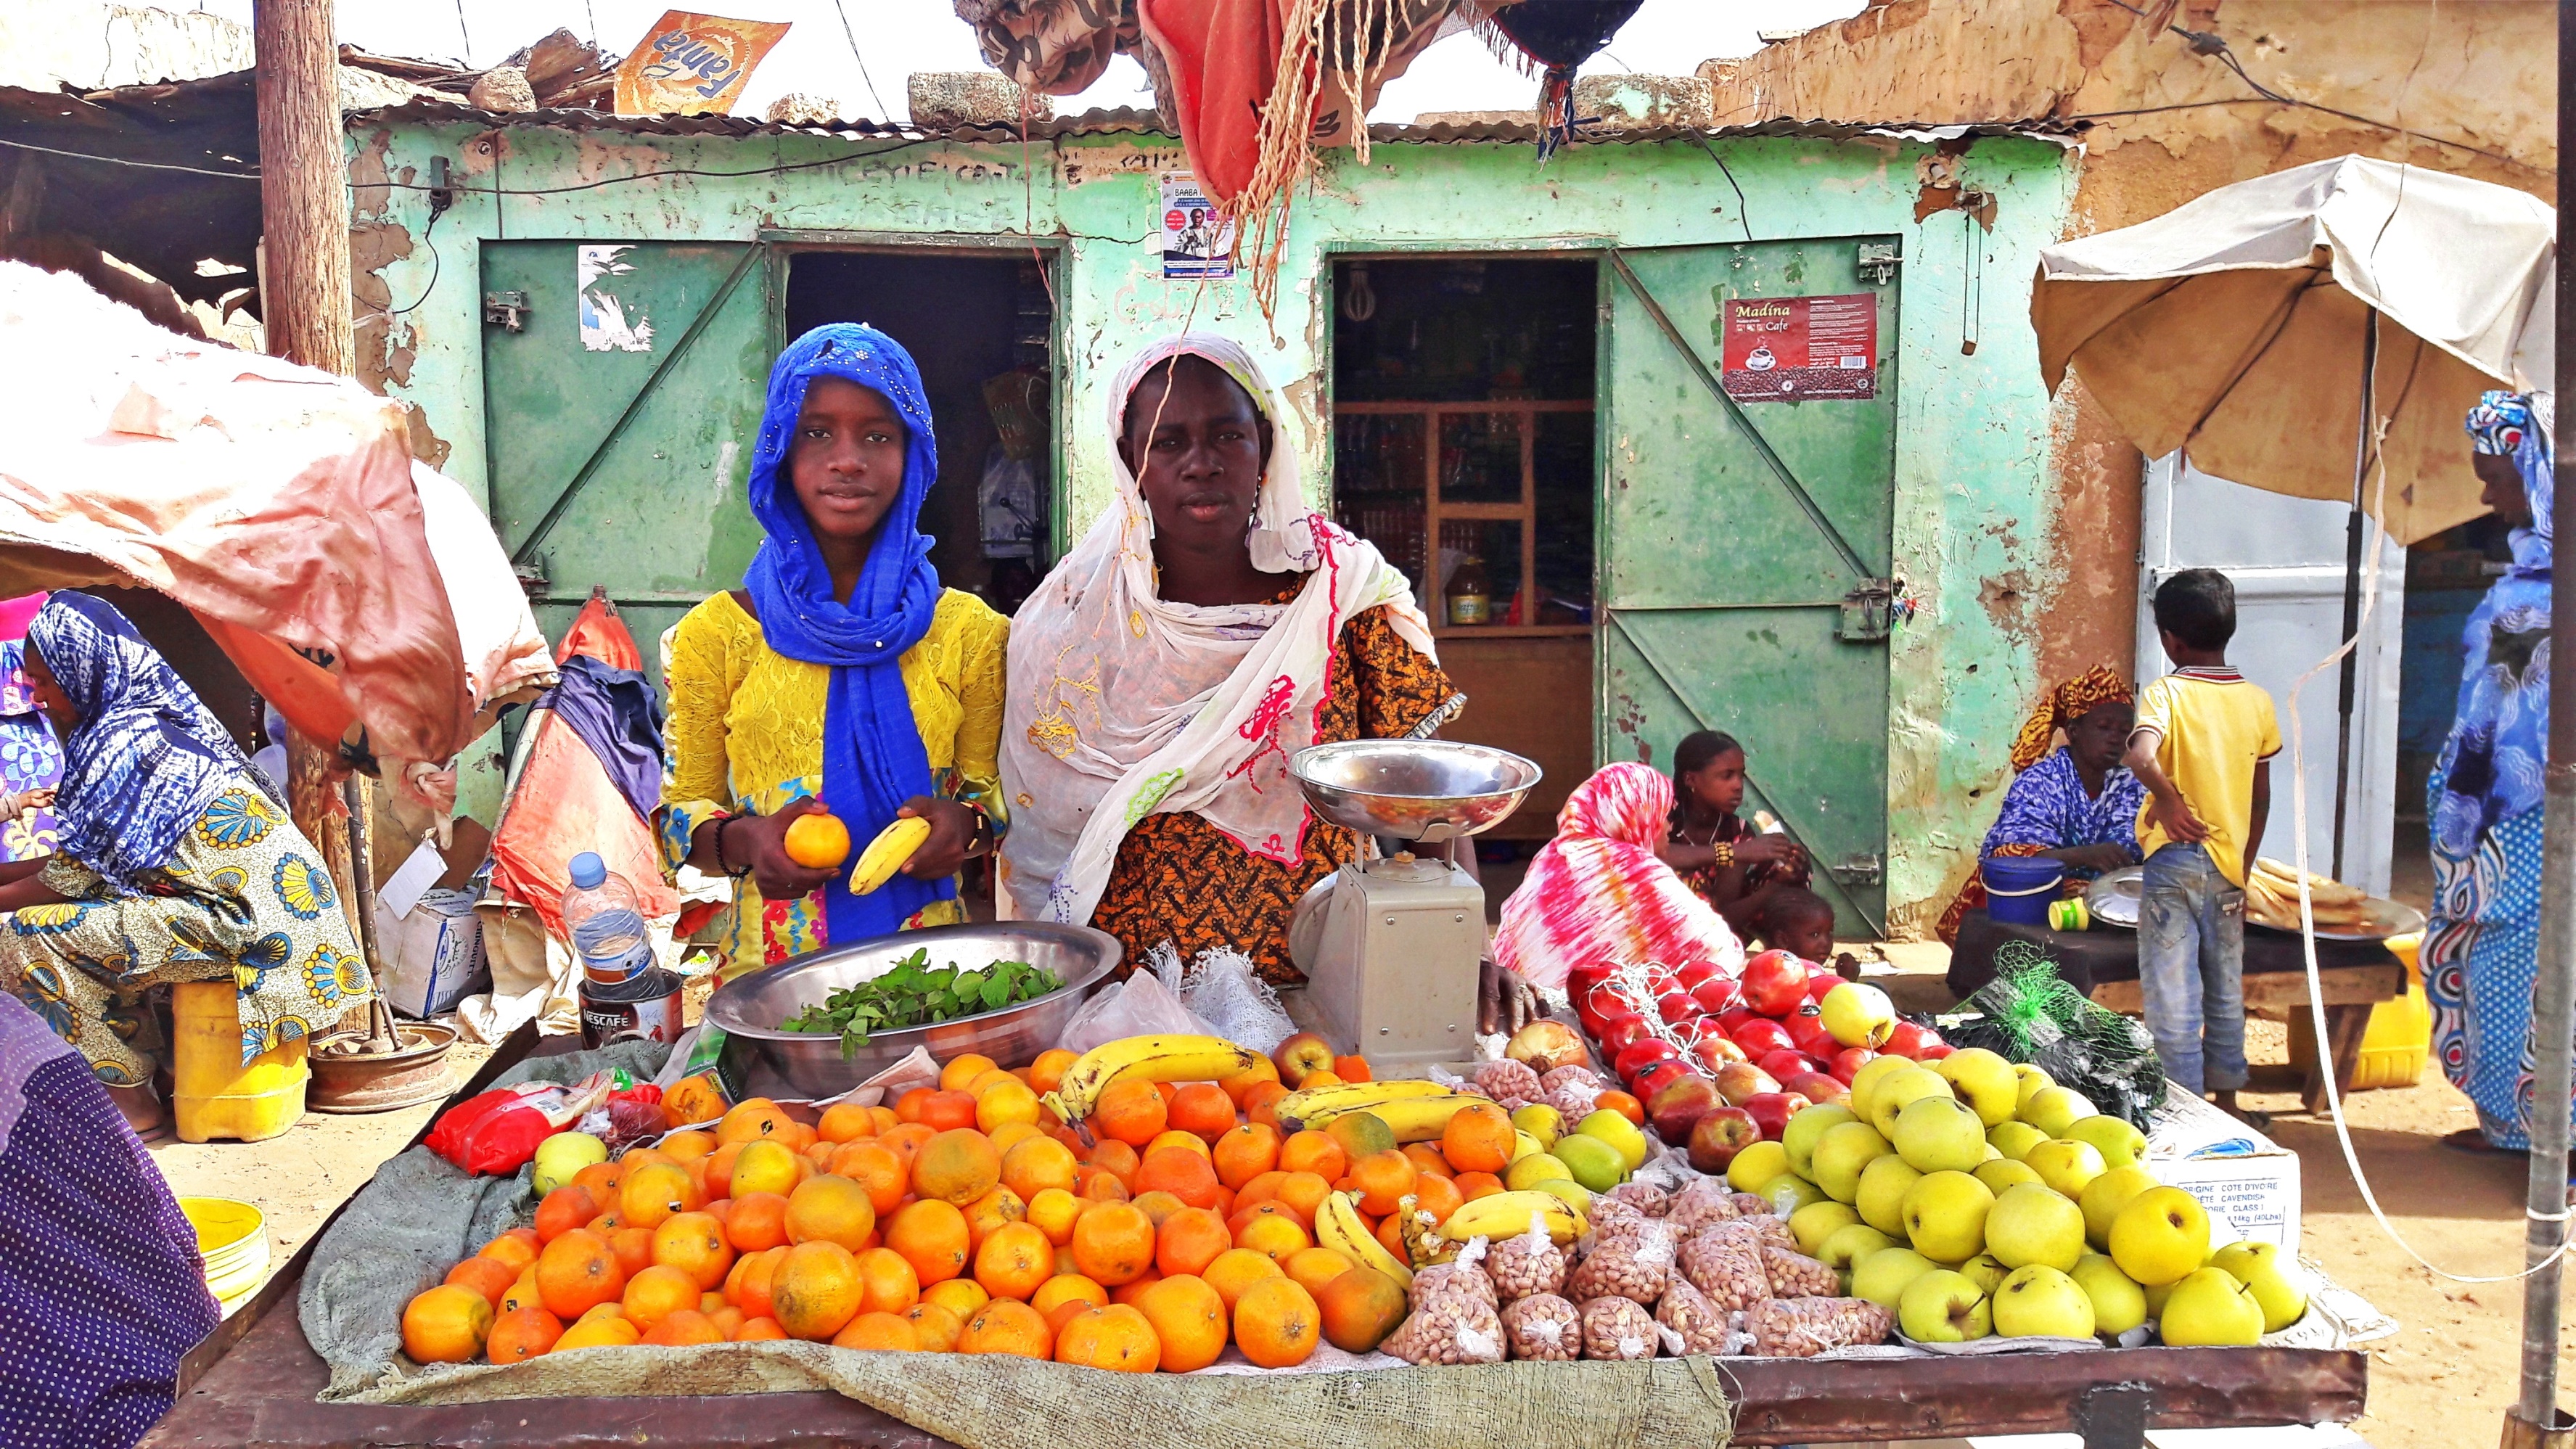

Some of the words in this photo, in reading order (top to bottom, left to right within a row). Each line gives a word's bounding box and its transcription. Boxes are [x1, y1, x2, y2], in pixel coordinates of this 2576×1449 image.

[653, 28, 741, 98] Fanta
[1175, 188, 1198, 197] BAABA
[1735, 302, 1791, 318] Madina
[1765, 318, 1789, 334] Cafe
